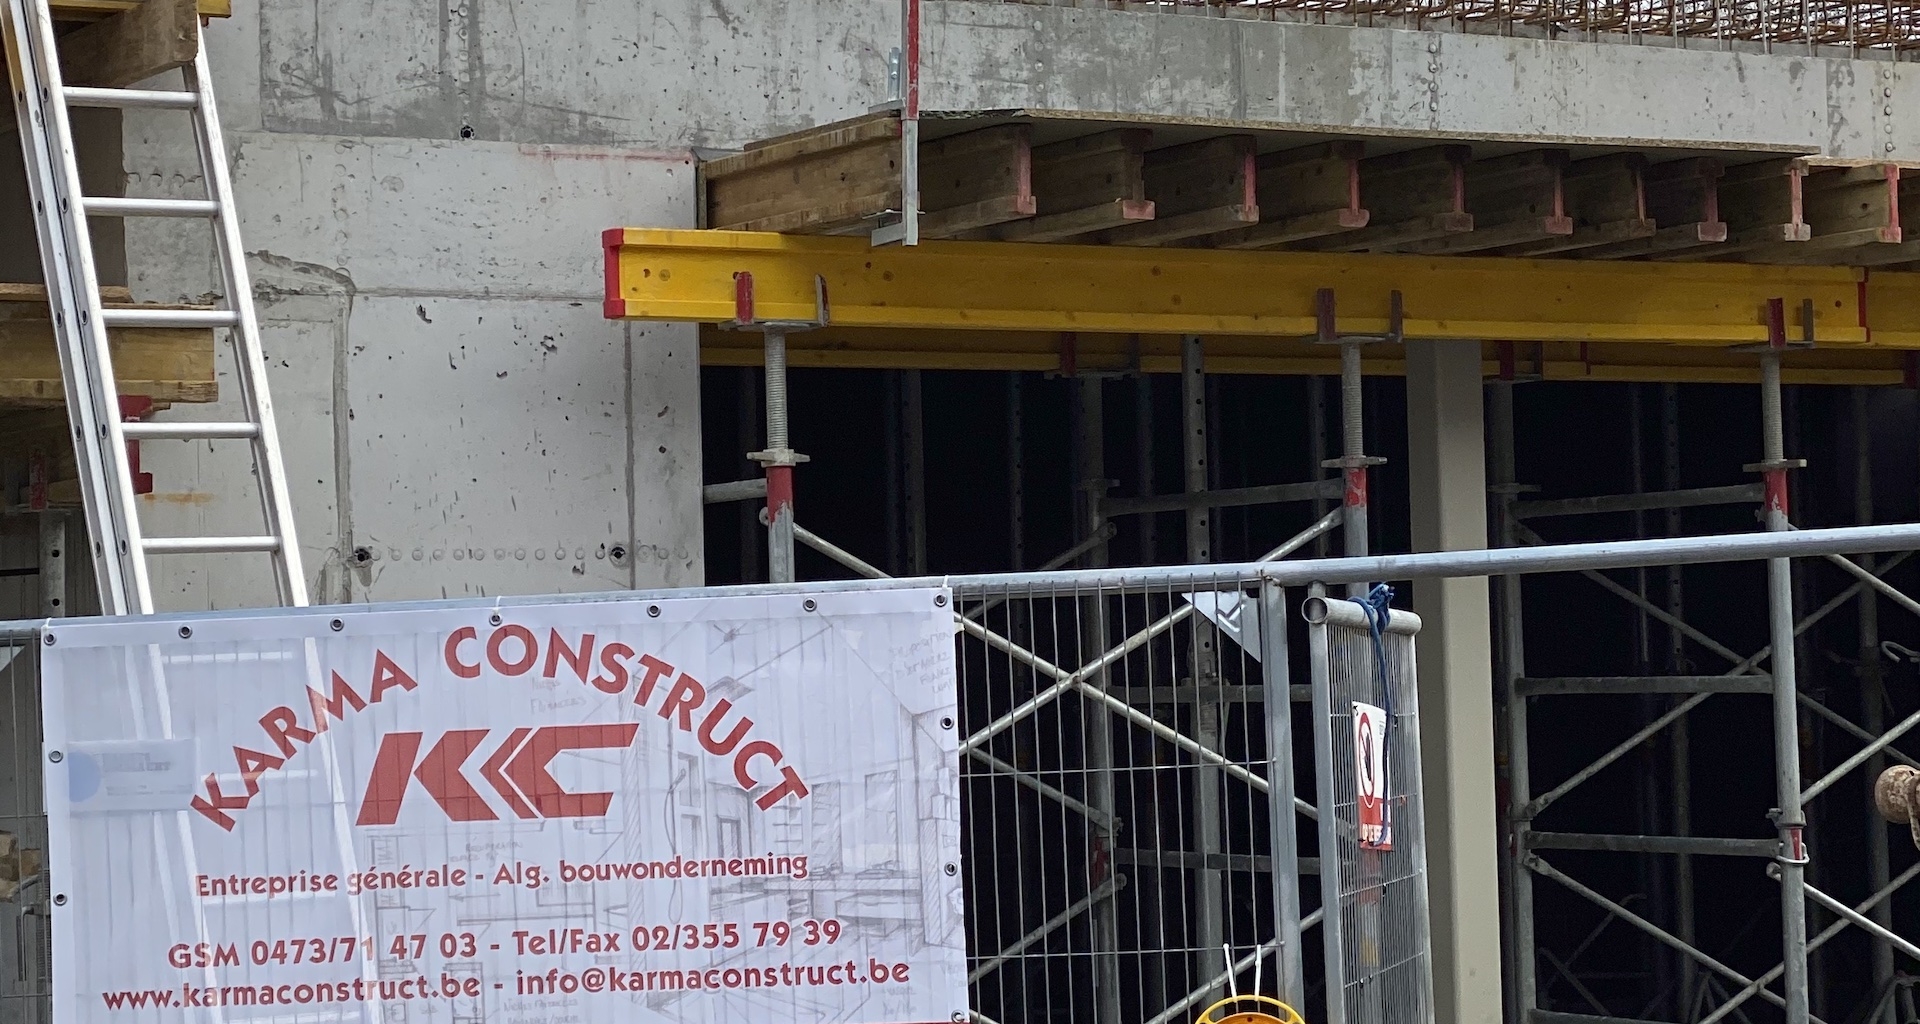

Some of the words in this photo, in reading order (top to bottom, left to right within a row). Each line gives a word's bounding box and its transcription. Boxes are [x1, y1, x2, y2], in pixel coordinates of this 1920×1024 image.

[190, 649, 418, 832] KARMA
[444, 623, 810, 811] CONSTRUCT
[195, 874, 339, 897] Entreprise
[346, 865, 467, 895] générale
[493, 863, 550, 890] Alg.
[560, 852, 809, 883] bouwonderneming
[168, 943, 240, 969] GSM
[251, 936, 374, 966] 0473/71
[389, 934, 427, 960] 47
[439, 932, 478, 958] 03
[512, 927, 621, 955] Tel/Fax
[631, 922, 741, 951] 02/355
[752, 920, 792, 948] 79
[804, 919, 842, 945] 39
[102, 973, 481, 1011] www.karmaconstruct.be
[516, 958, 910, 996] info@karmaconstruct.be
